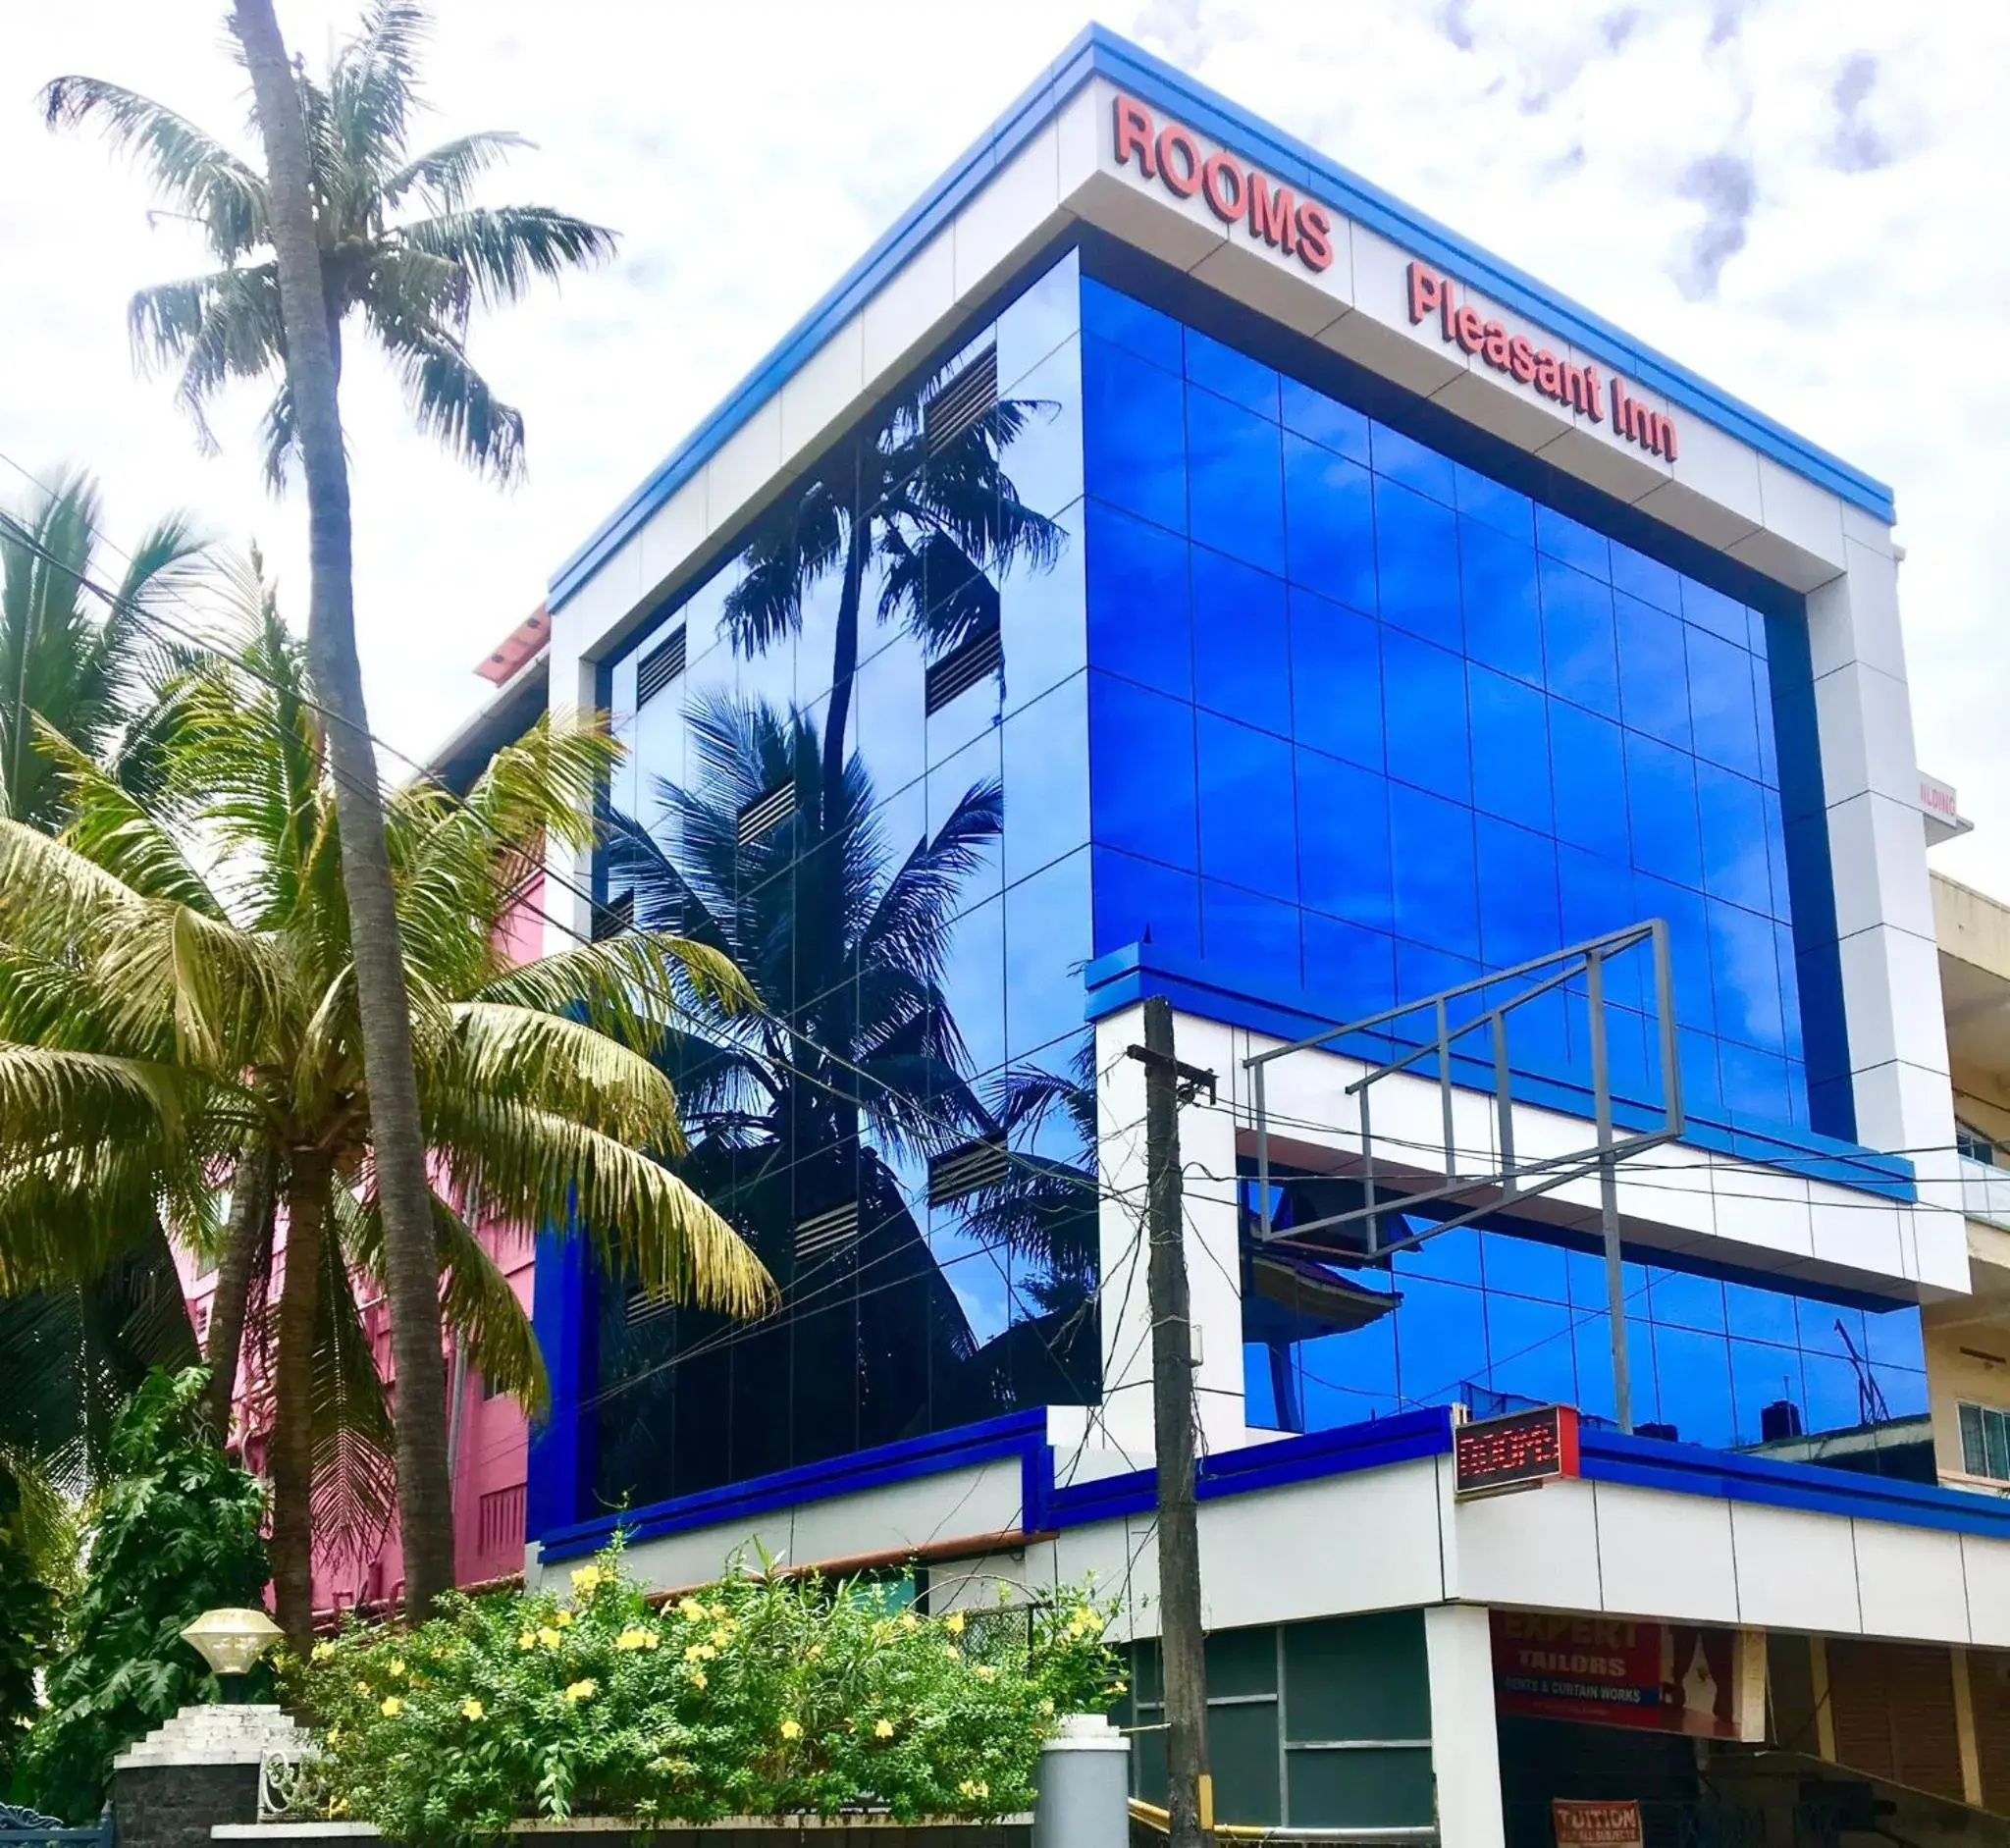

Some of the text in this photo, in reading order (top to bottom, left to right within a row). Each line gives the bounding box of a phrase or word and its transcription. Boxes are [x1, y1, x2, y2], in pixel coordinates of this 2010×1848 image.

[1113, 94, 1333, 273] ROOMS
[1406, 261, 1678, 463] Pleasant Inn
[1517, 1649, 1627, 1677] TAILORS
[1552, 1681, 1599, 1700] CURTAIN
[1600, 1684, 1641, 1703] WORKS
[1557, 1809, 1636, 1829] TUITION
